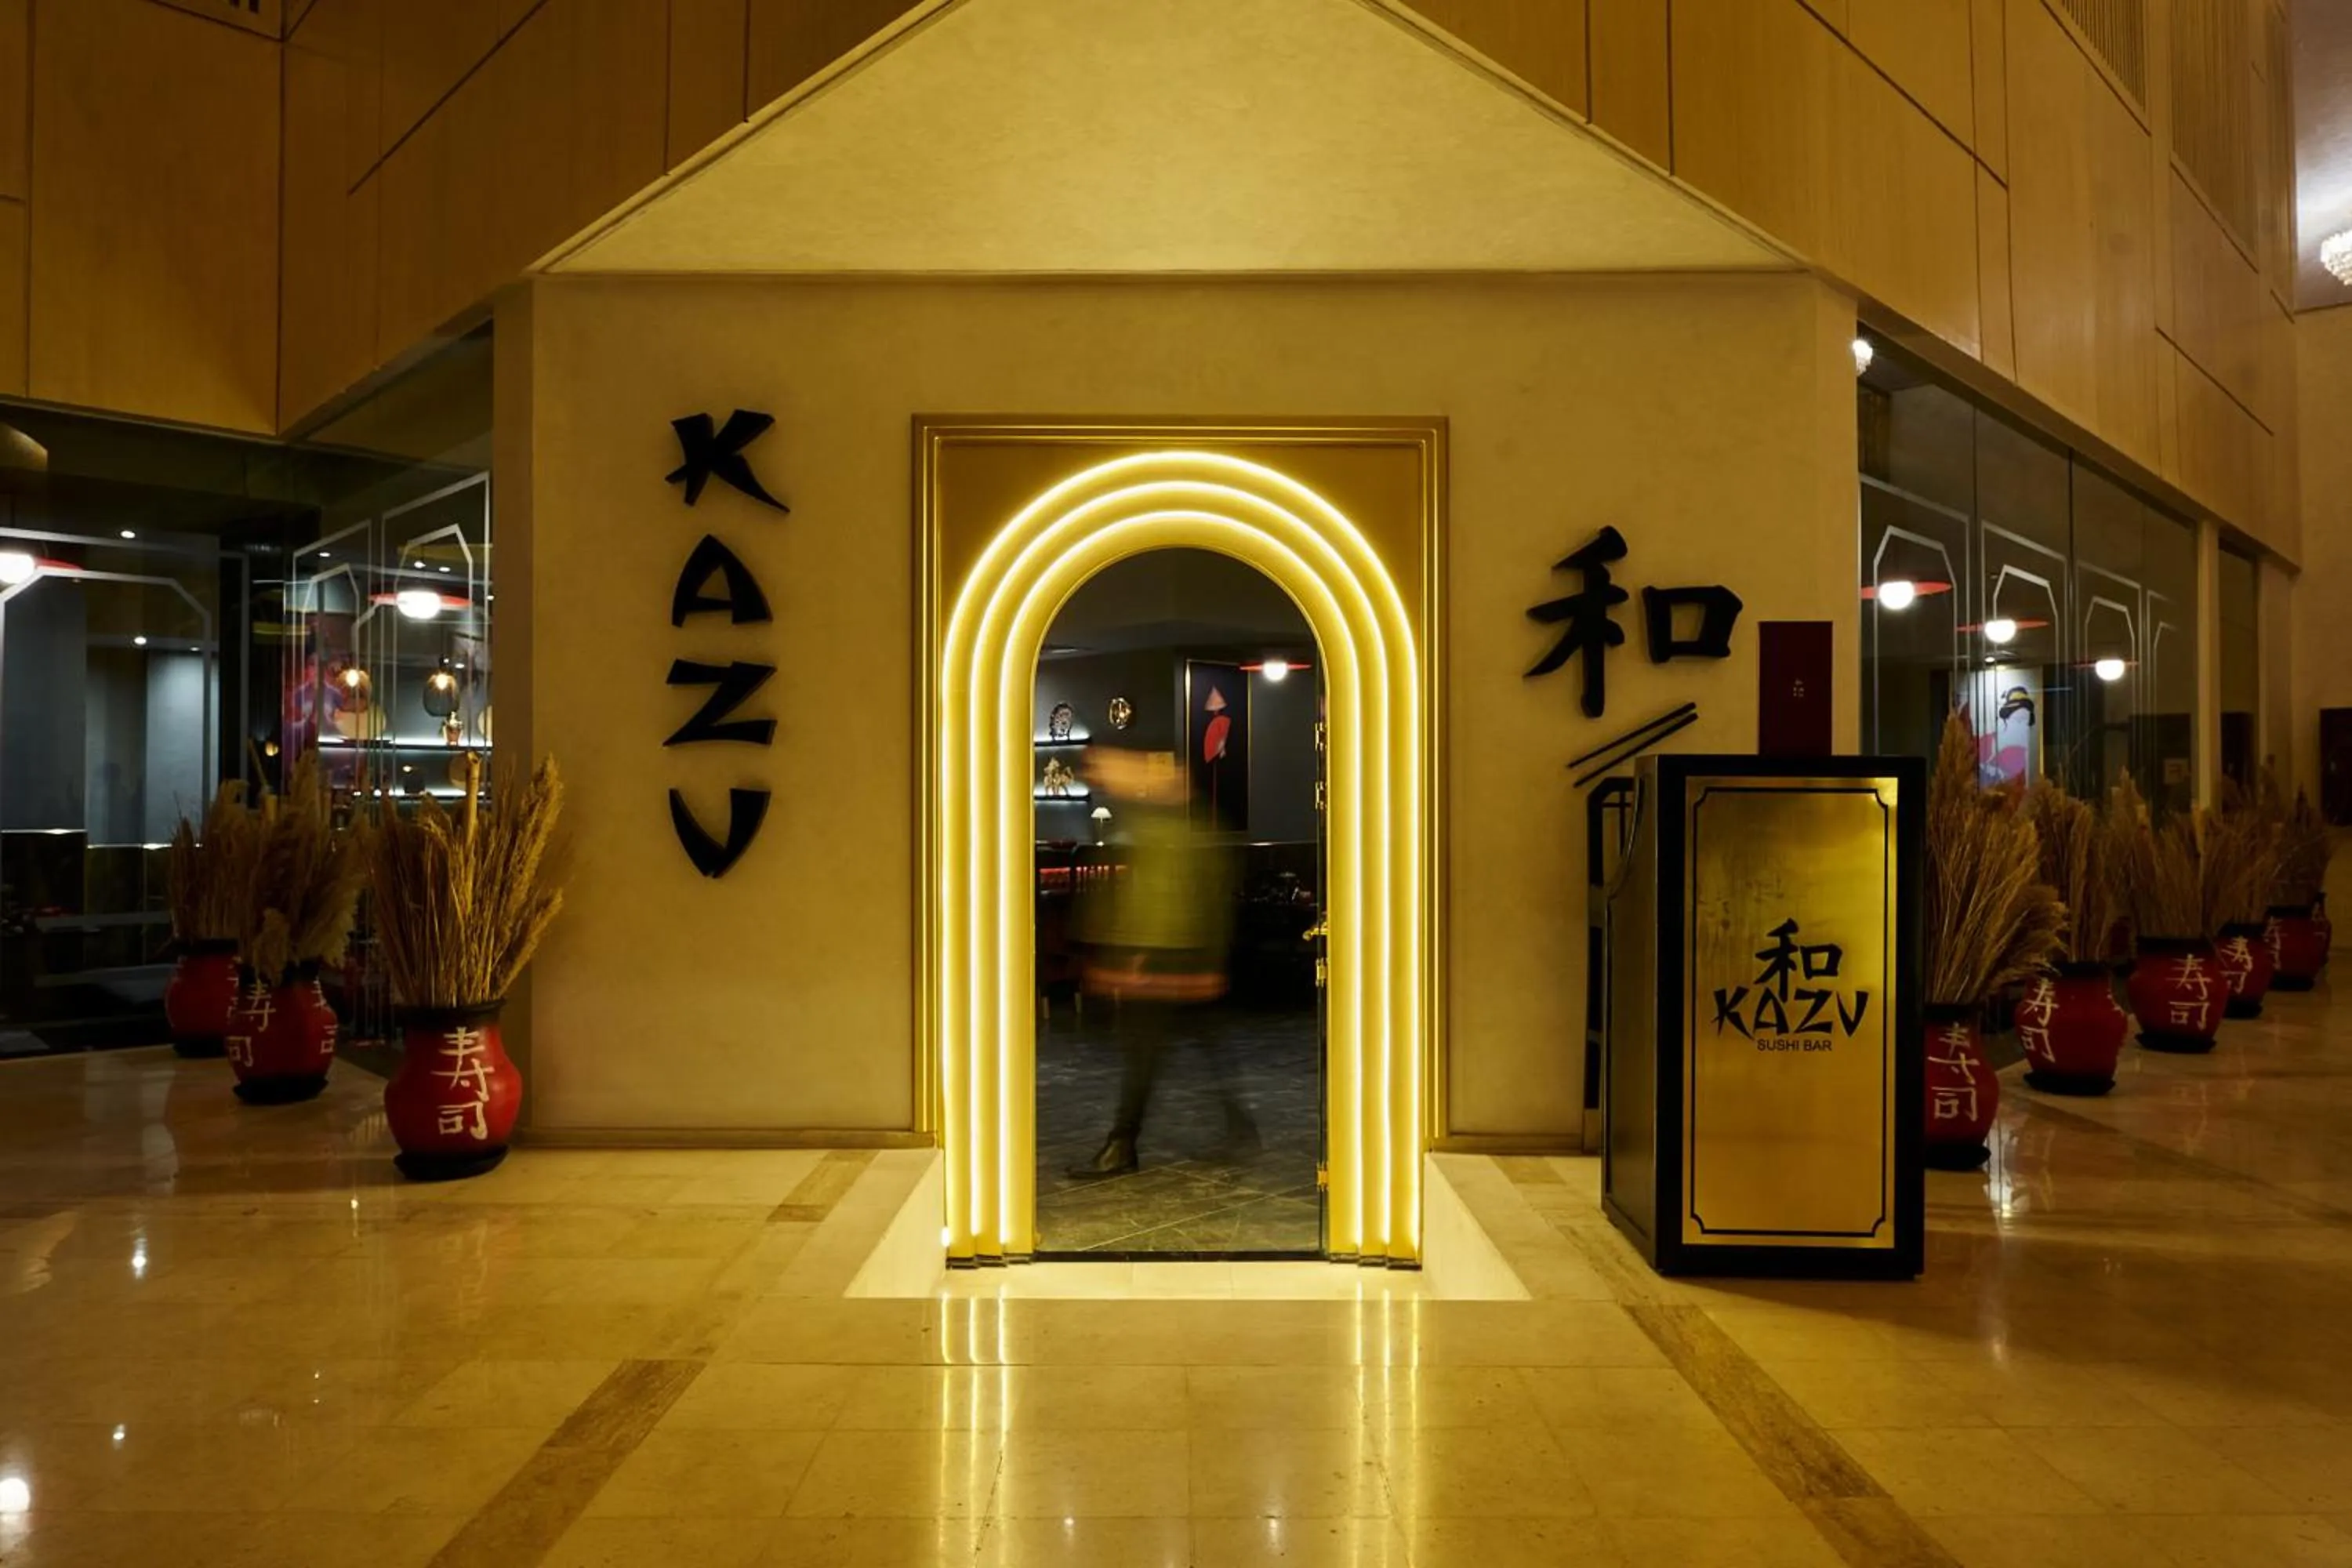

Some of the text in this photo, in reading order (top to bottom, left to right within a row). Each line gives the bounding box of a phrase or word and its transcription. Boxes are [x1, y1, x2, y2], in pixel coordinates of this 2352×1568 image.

[1523, 524, 1744, 718] 和
[1754, 917, 1843, 1004] 和
[2165, 954, 2212, 1030] 寿司
[227, 978, 276, 1069] 寿司
[1757, 1039, 1832, 1051] SUSHI BAR
[2020, 976, 2060, 1064] 寿司
[430, 1025, 495, 1140] 寿司
[1927, 1022, 1981, 1122] 寿司
